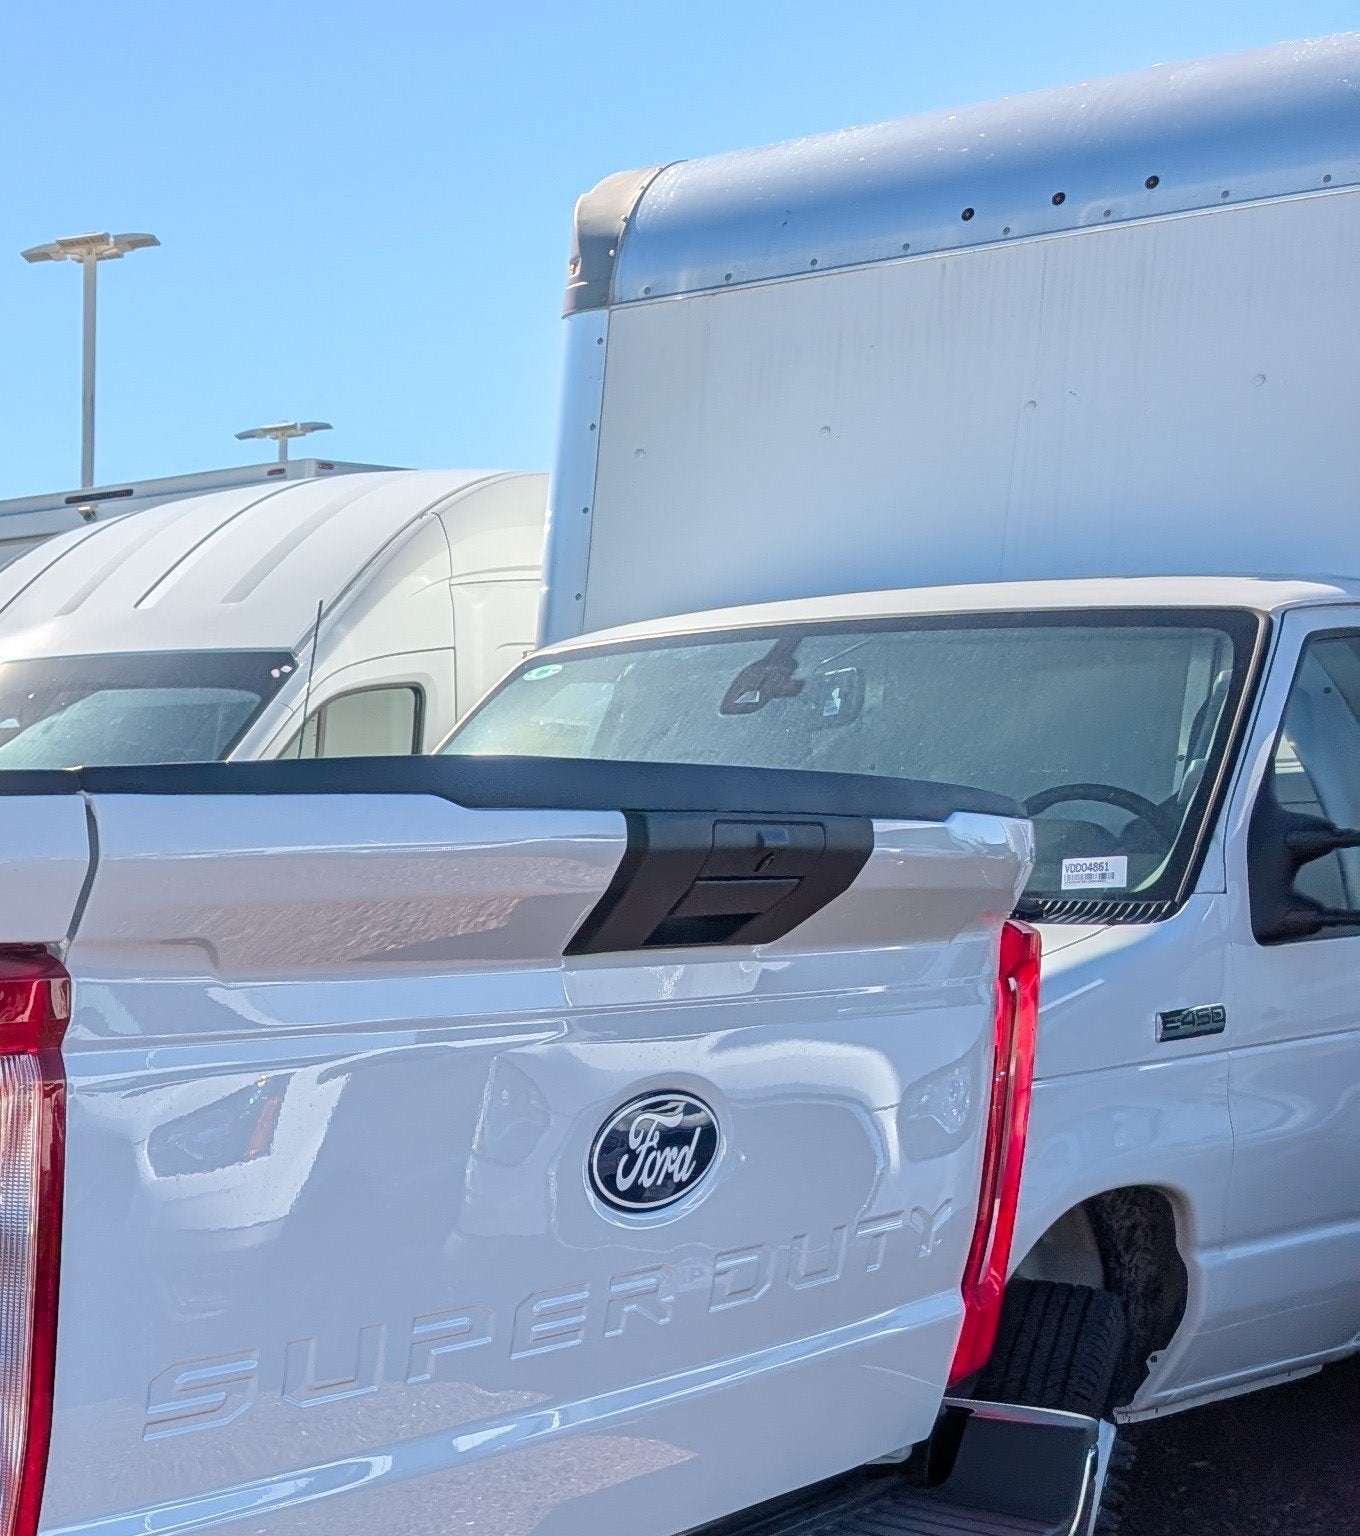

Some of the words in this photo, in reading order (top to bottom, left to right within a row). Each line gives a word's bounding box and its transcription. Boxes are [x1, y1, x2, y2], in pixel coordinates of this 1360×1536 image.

[615, 1112, 702, 1192] Ford
[142, 1262, 675, 1441] SUPER
[707, 1197, 954, 1313] DUTY
